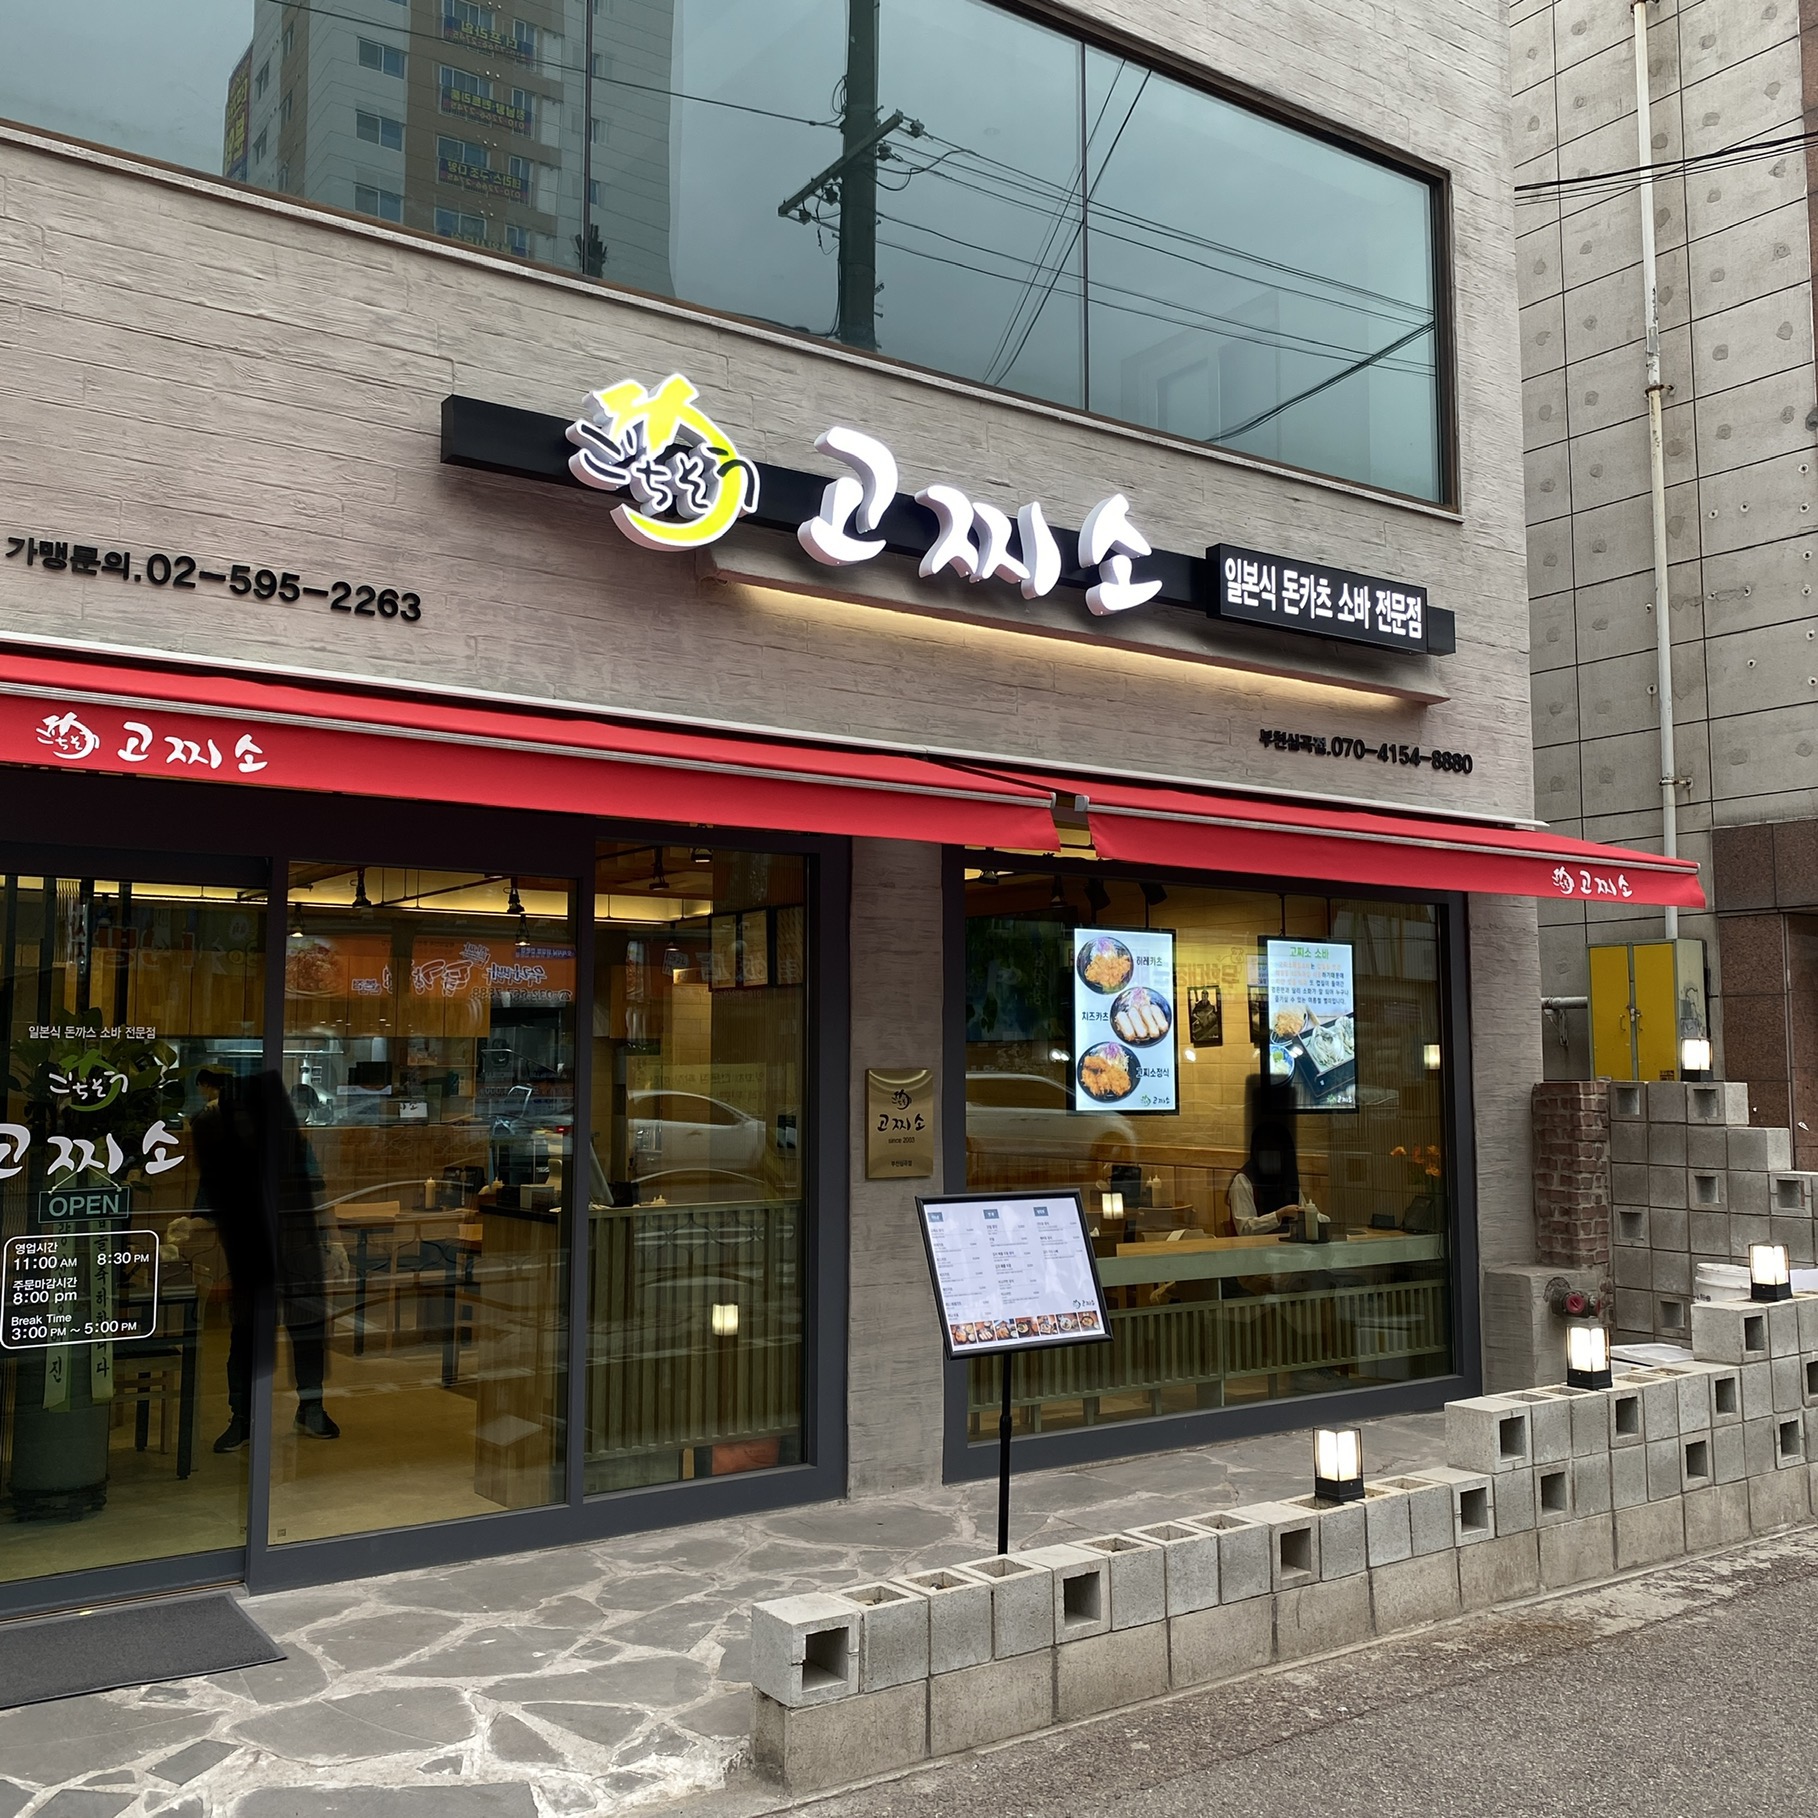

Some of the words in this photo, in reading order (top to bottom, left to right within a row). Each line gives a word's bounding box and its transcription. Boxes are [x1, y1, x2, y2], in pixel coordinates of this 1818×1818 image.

[797, 427, 1163, 616] 고찌소
[1224, 557, 1277, 612] 일본식
[1281, 569, 1334, 620] 돈카츠
[1337, 582, 1371, 630] 소바
[1375, 589, 1423, 640] 전문점
[117, 720, 268, 773] 고찌소
[1579, 869, 1633, 898] 고찌소
[1315, 948, 1329, 960] 소바
[28, 1025, 61, 1039] 일본식
[64, 1025, 97, 1039] 돈까스
[99, 1025, 121, 1039] 소바
[125, 1026, 156, 1039] 전문점
[49, 1071, 129, 1100] ごちそう
[877, 1113, 926, 1132] 고찌소
[902, 1136, 916, 1144] 2003
[48, 1194, 120, 1217] OPEN
[14, 1242, 58, 1256] 영업시간
[14, 1256, 58, 1271] 11:00
[60, 1257, 78, 1268] AM
[97, 1252, 132, 1266] 8:30
[133, 1253, 150, 1263] PM
[12, 1277, 78, 1291] 주문마감시간
[12, 1291, 50, 1306] 8:00
[54, 1291, 78, 1304] pm
[11, 1315, 43, 1327] Break
[46, 1313, 72, 1324] Time
[11, 1326, 48, 1341] 3:00
[50, 1327, 67, 1337] PM
[84, 1320, 119, 1335] 5:00
[121, 1321, 137, 1332] PM
